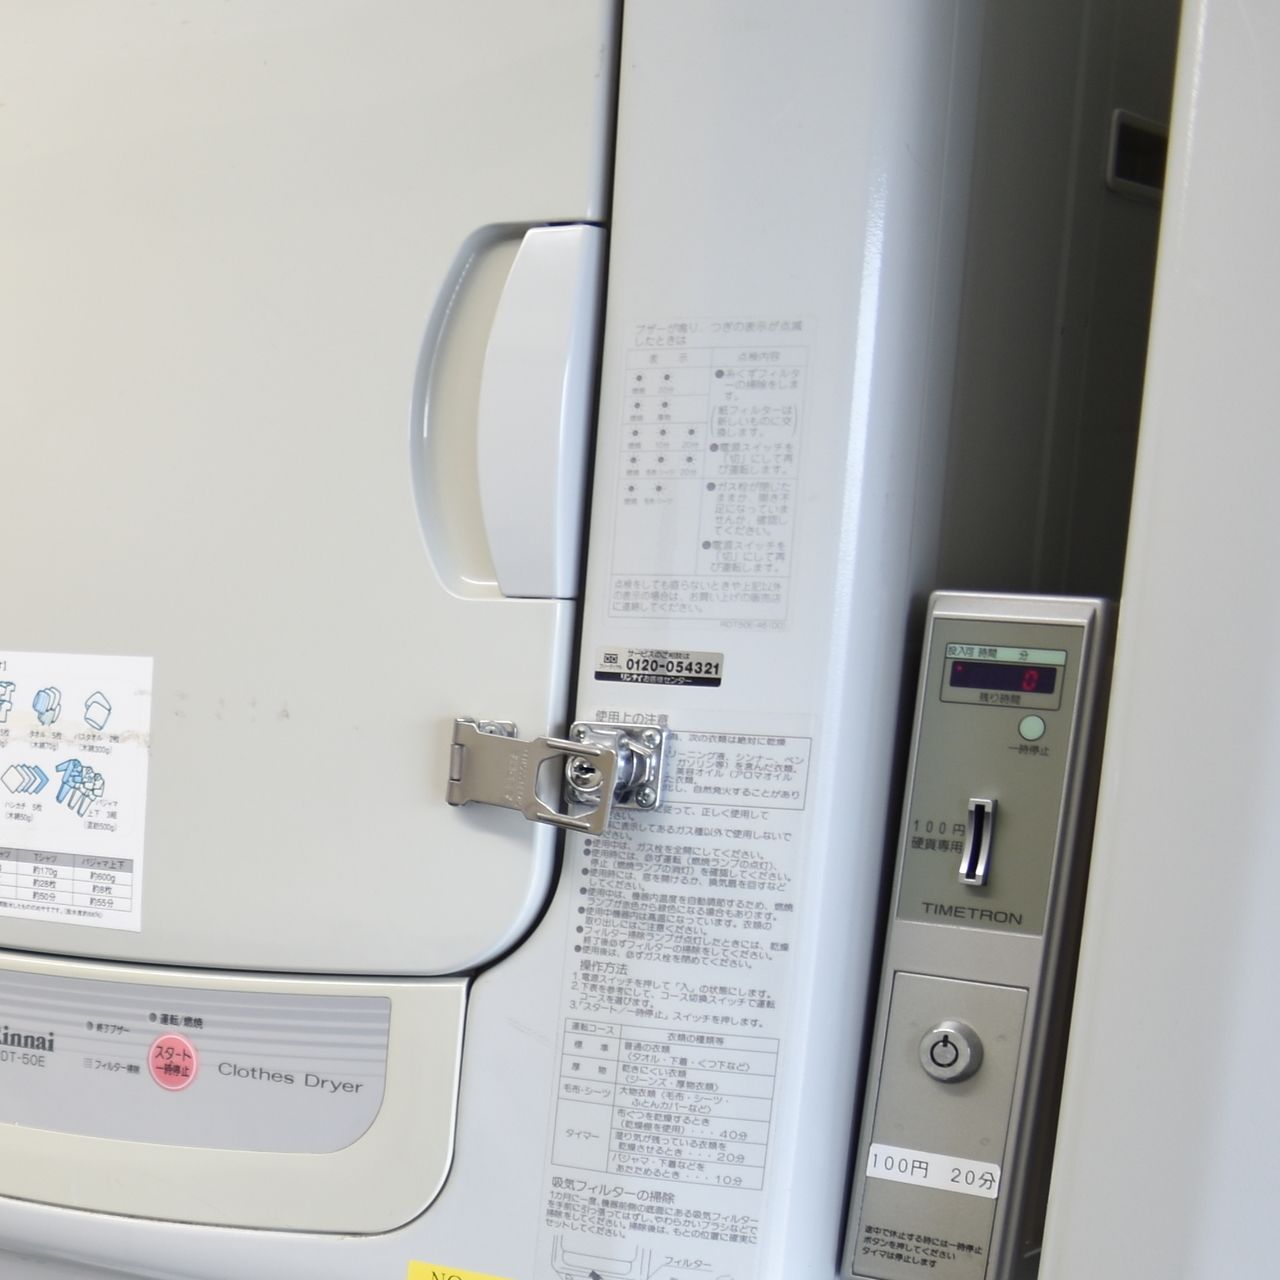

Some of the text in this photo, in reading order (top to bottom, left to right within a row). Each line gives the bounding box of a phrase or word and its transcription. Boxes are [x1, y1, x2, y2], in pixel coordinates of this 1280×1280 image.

[626, 659, 720, 675] 0120-054321
[980, 692, 1021, 705] 残り時間
[596, 710, 669, 728] 使用上の注意
[1008, 744, 1050, 757] 一時停止
[912, 818, 966, 839] 100円
[911, 836, 963, 854] 硬貨専用
[33, 865, 58, 878] 約170g
[90, 871, 116, 884] 約600g
[33, 878, 56, 889] 約28枚
[92, 884, 112, 895] 約8枚
[33, 890, 56, 902] 約50分
[90, 896, 114, 909] 約55分
[921, 902, 1023, 926] TIMETRON
[579, 959, 628, 976] 操作方法
[571, 1021, 725, 1046] 運転コース 衣類の種類等
[155, 1045, 192, 1060] スタート
[624, 1041, 671, 1054] 普通の衣類
[156, 1063, 190, 1077] 一時停止
[218, 1061, 364, 1094] Clothes Dryer
[622, 1064, 687, 1078] 乾きにくい衣類
[565, 1128, 600, 1140] タイマー
[872, 1153, 996, 1191] 100円 20分
[551, 1176, 676, 1204] 吸気フィルターの掃除
[862, 1246, 937, 1268] タイマは停止します
[864, 1236, 956, 1261] ボタンを押してください
[664, 1256, 712, 1269] フィルター
